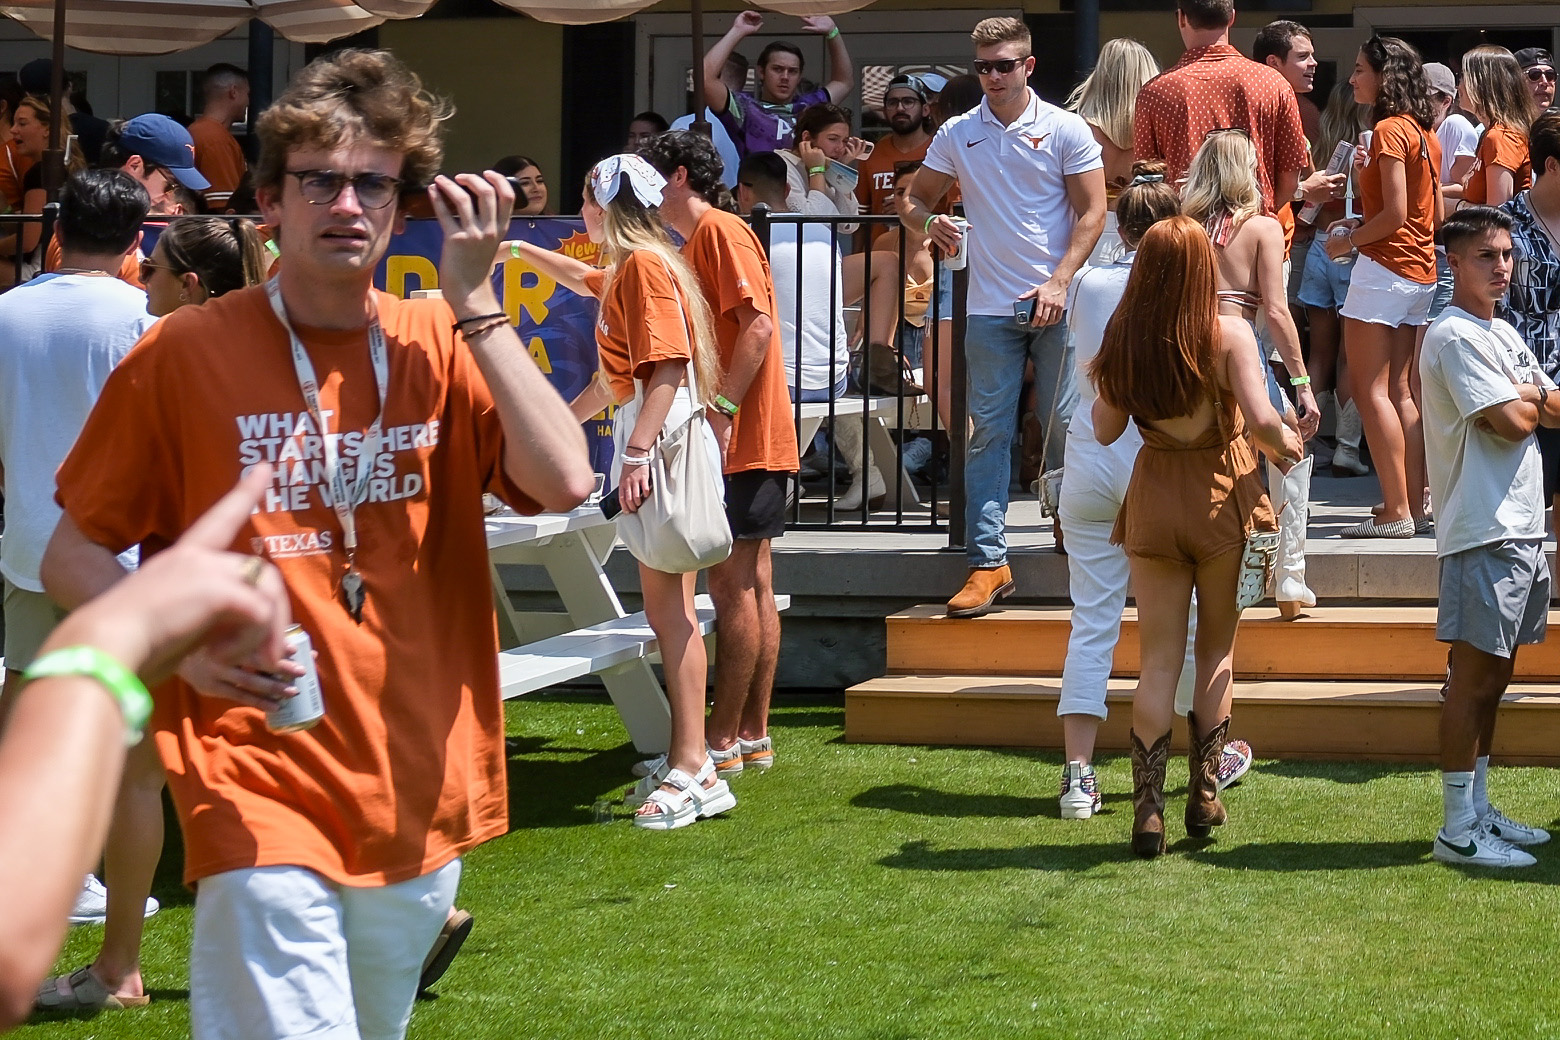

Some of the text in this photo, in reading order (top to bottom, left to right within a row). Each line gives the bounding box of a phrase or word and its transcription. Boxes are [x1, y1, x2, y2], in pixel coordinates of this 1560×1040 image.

[236, 410, 334, 440] WHAT
[372, 421, 440, 453] HERE
[264, 531, 332, 553] TEXAS
